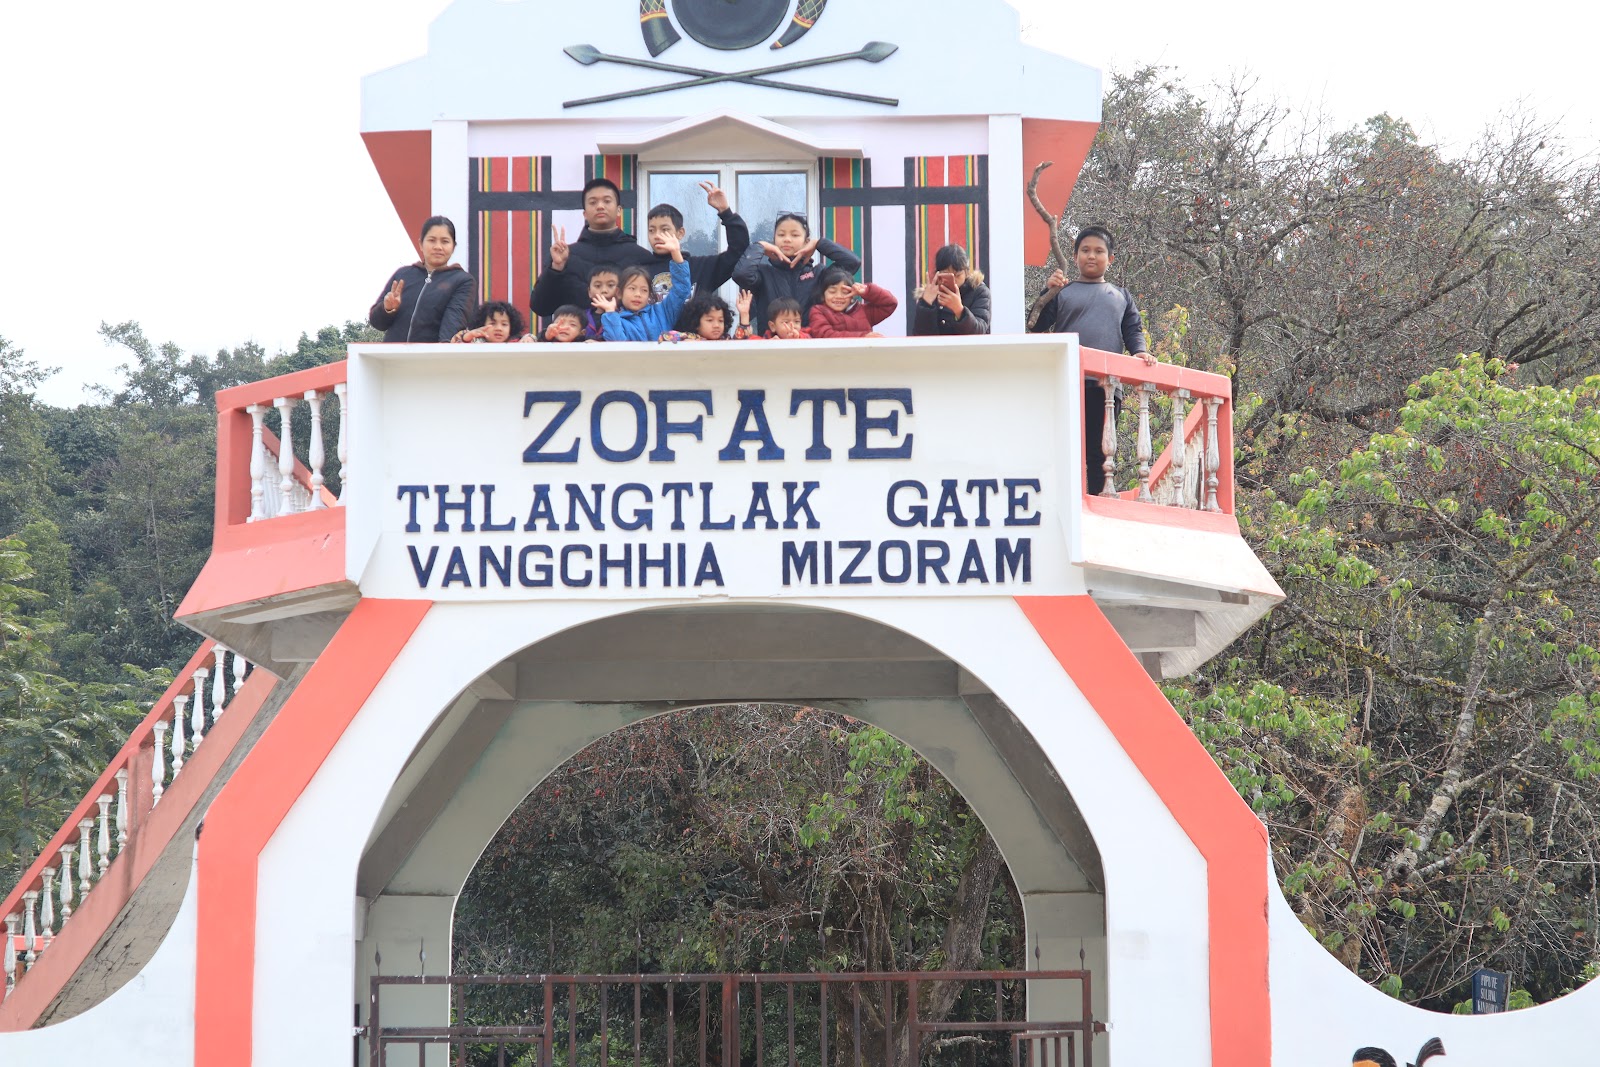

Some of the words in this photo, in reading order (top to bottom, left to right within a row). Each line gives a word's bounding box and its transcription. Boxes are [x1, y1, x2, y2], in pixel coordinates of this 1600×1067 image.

[523, 388, 914, 463] ZOFATE
[397, 482, 820, 532] THLANGTLAK
[887, 479, 1042, 527] GATE
[408, 543, 725, 588] VANGCHHIA
[783, 538, 1032, 586] MIZORAM
